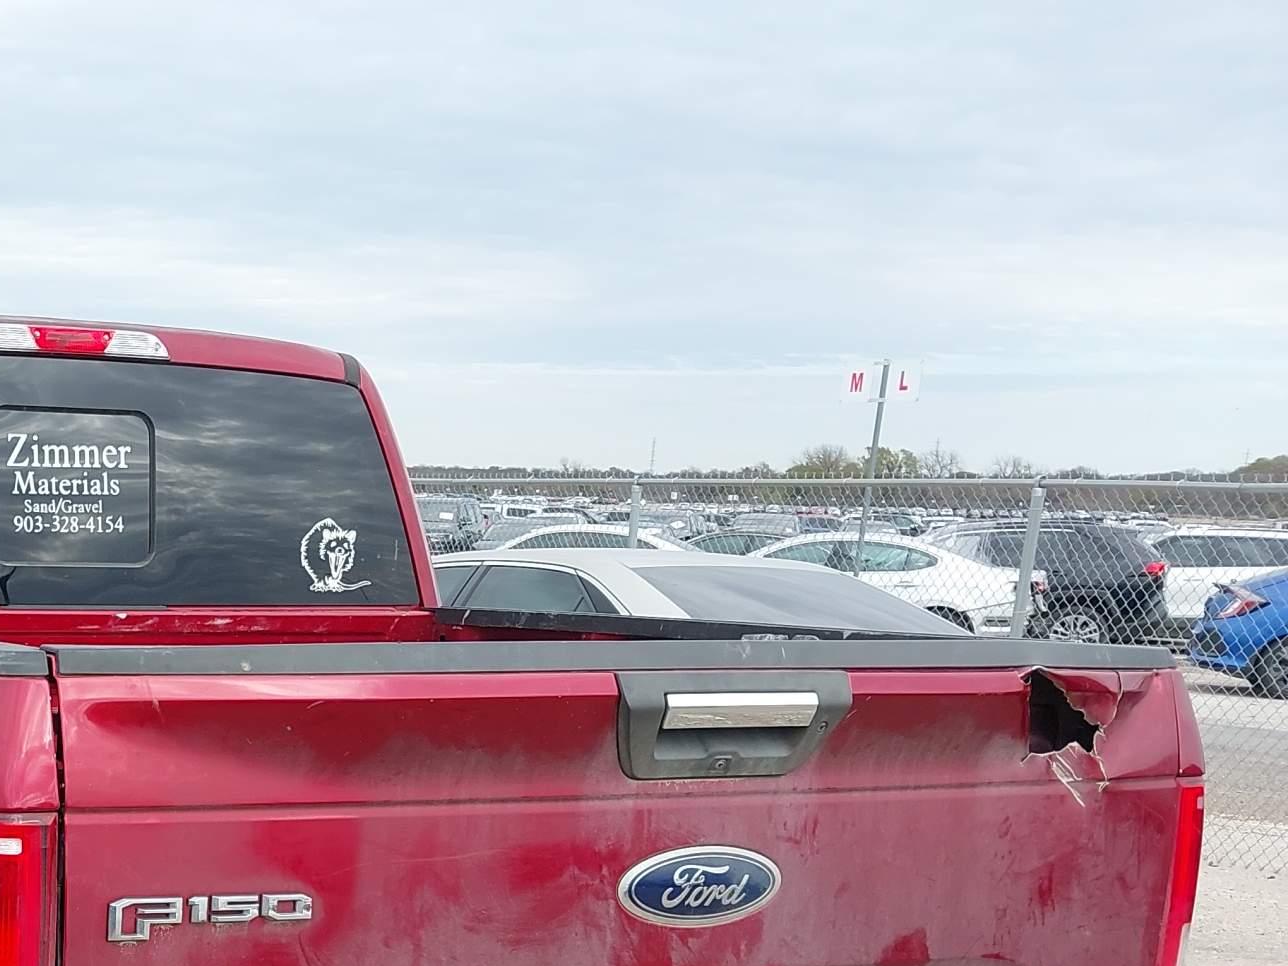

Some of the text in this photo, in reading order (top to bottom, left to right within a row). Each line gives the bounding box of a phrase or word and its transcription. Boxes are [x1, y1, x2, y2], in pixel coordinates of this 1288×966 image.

[849, 372, 864, 392] M
[898, 370, 909, 391] L
[6, 433, 132, 469] Zimmer
[12, 471, 121, 496] Materials
[23, 498, 103, 514] Sand/Gravel
[13, 515, 125, 533] 903-328-4154
[661, 864, 750, 909] Ford
[108, 893, 313, 942] F150
